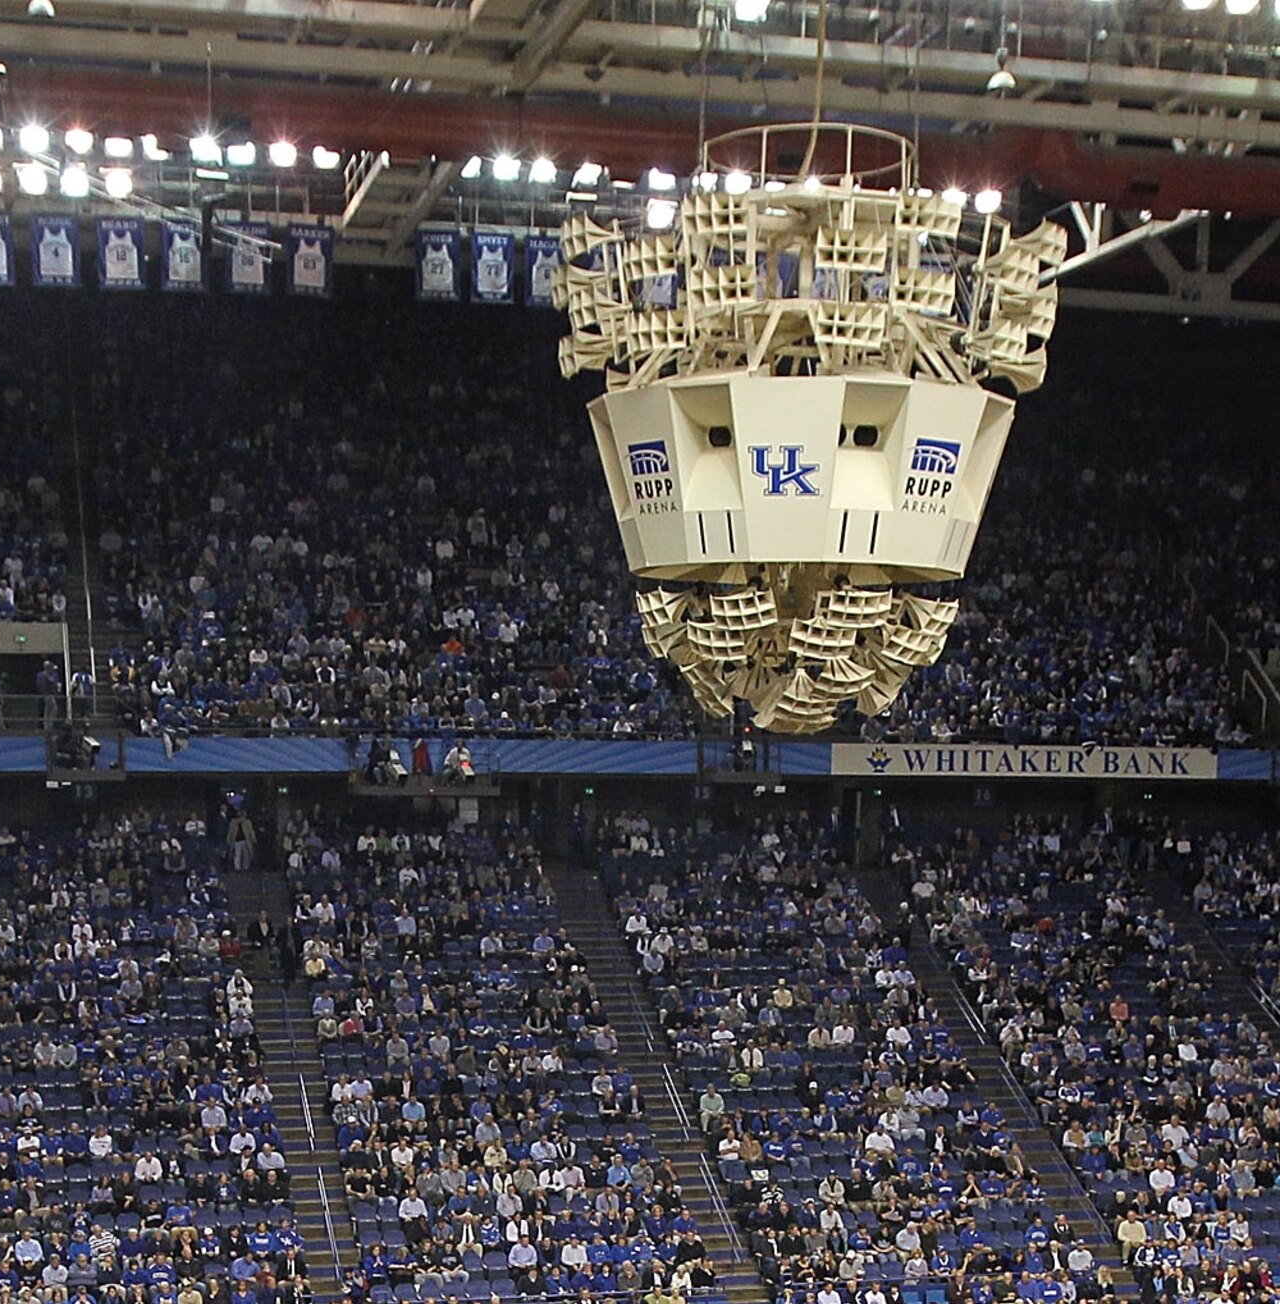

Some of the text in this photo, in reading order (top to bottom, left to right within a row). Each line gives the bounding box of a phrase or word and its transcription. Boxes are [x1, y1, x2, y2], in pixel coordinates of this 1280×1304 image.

[748, 445, 820, 496] UK
[634, 477, 673, 499] RUPP
[905, 477, 952, 498] RUPP
[639, 500, 678, 515] ARENA
[901, 499, 949, 515] ARENA
[903, 749, 1192, 776] WHITAKER BANK
